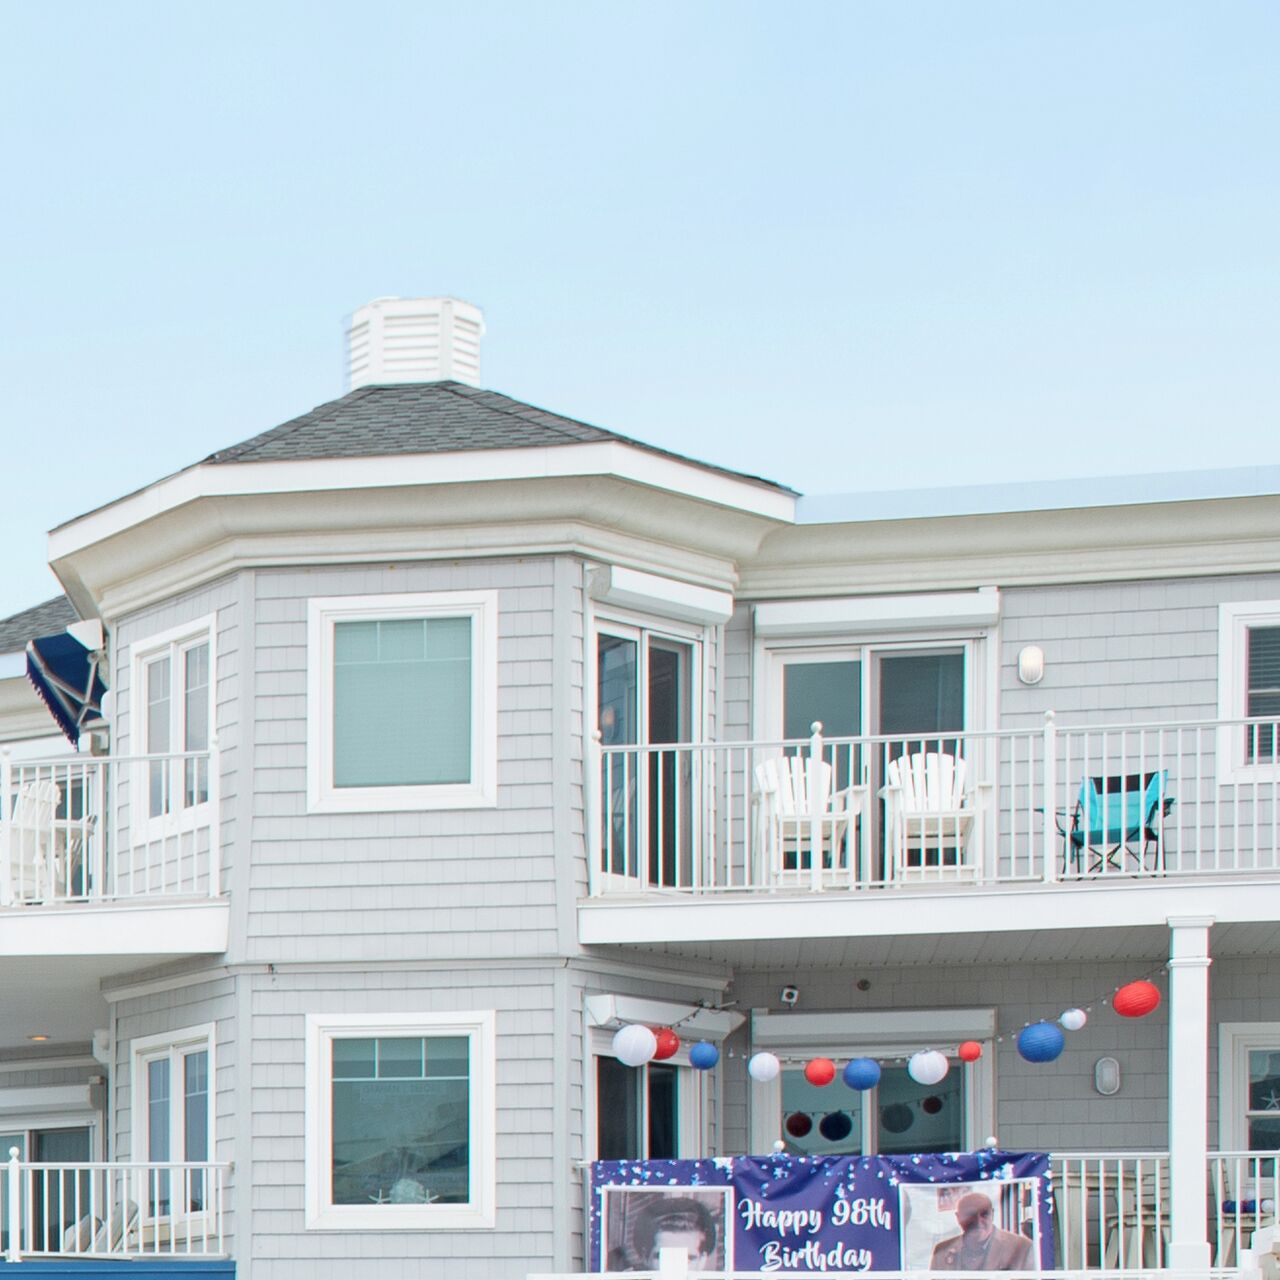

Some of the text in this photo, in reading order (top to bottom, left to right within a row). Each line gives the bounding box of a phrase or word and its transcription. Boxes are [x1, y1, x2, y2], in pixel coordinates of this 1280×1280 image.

[737, 1197, 892, 1238] Happy 98th
[759, 1240, 873, 1272] Birthday
